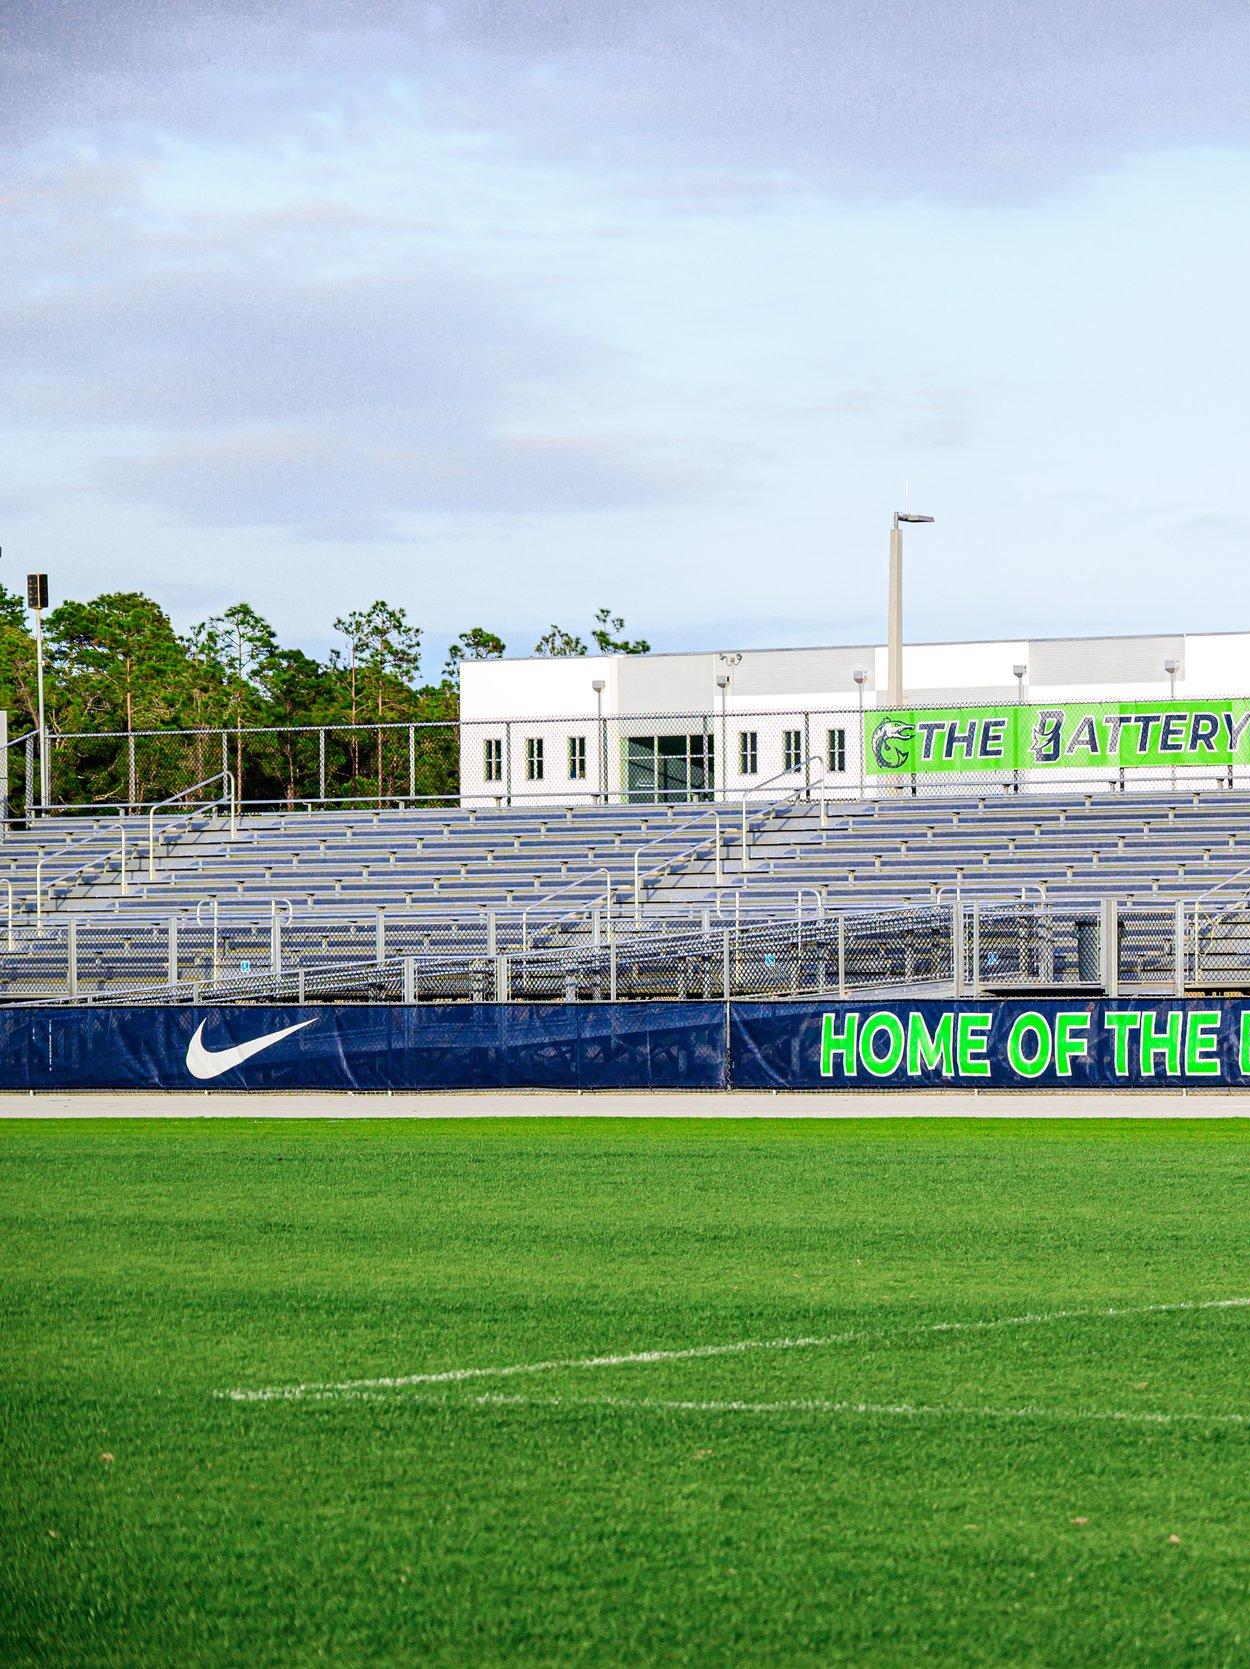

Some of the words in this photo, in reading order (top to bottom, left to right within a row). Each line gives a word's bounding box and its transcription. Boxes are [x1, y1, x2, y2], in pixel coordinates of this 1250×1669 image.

[916, 717, 1007, 761] THE
[820, 1011, 993, 1077] HOME
[1008, 1010, 1091, 1078] OF
[1105, 1010, 1222, 1076] THE
